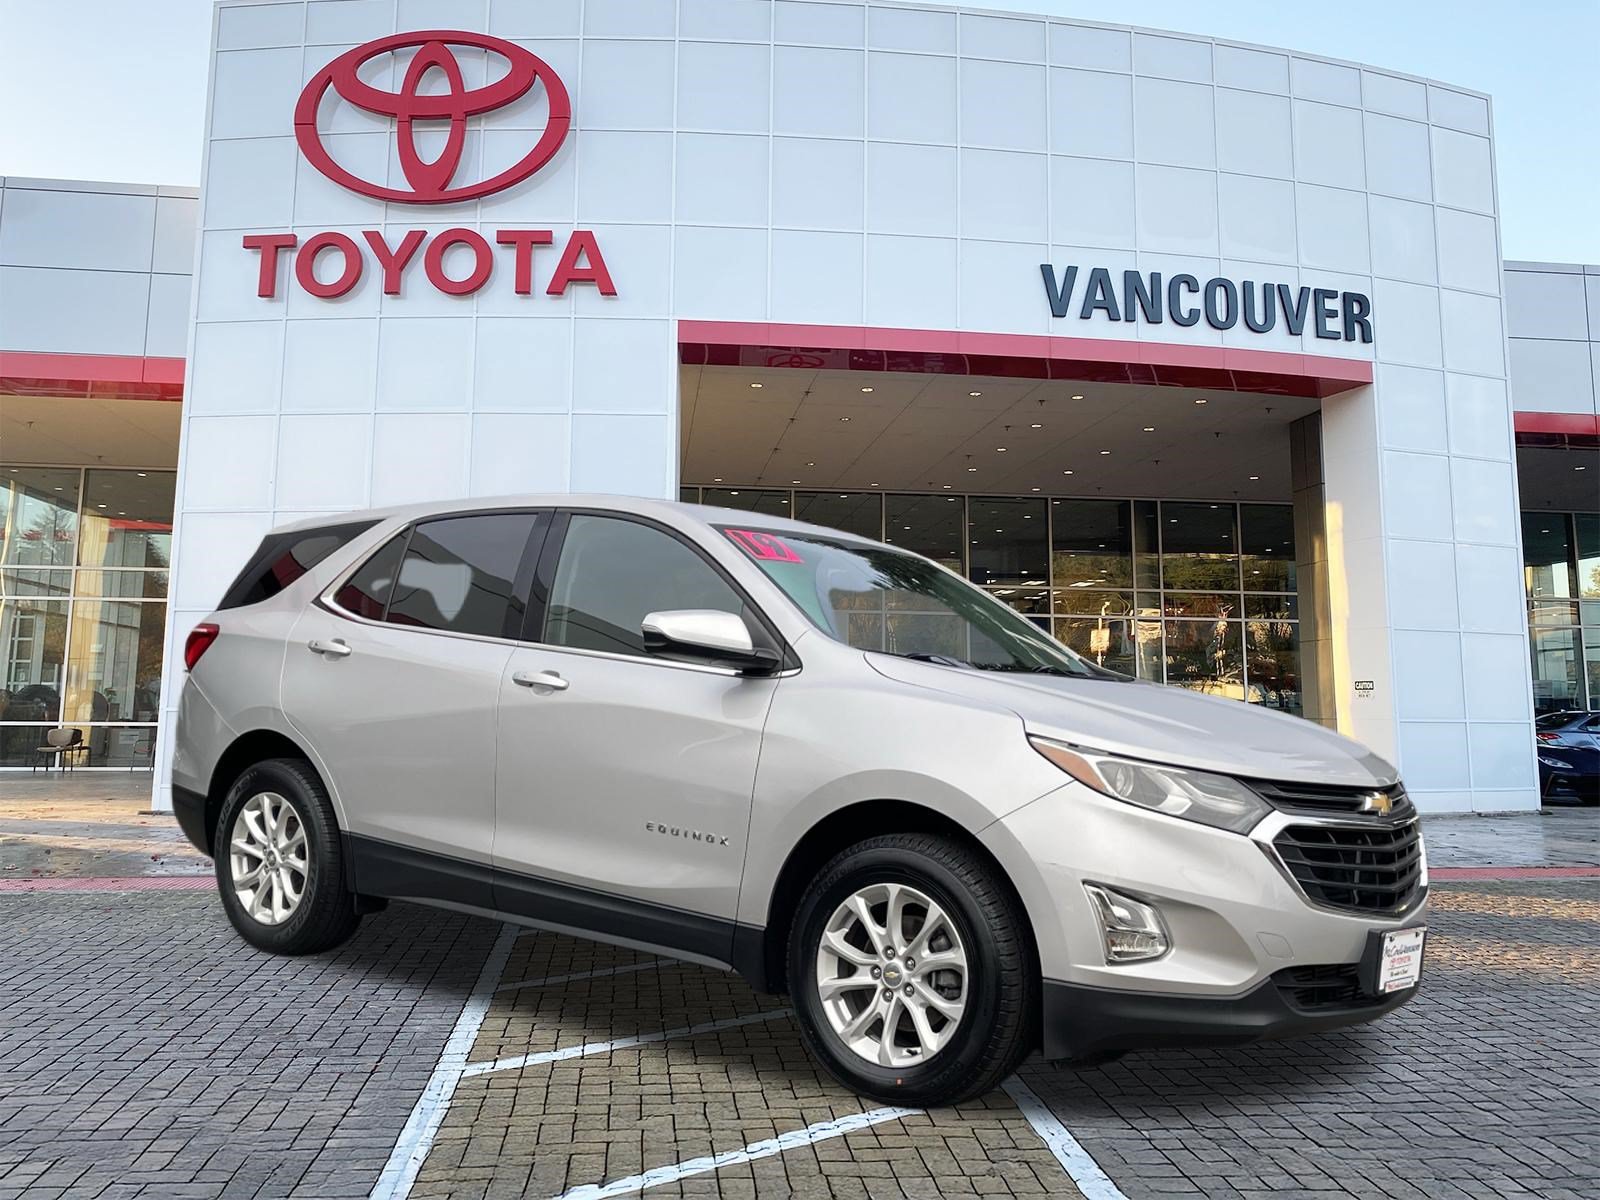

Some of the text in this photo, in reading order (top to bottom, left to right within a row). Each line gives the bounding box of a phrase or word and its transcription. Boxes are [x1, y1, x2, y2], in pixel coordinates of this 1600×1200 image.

[243, 228, 617, 298] TOYOTA
[1040, 264, 1373, 344] VANCOUVER
[646, 821, 729, 847] EQUINOX
